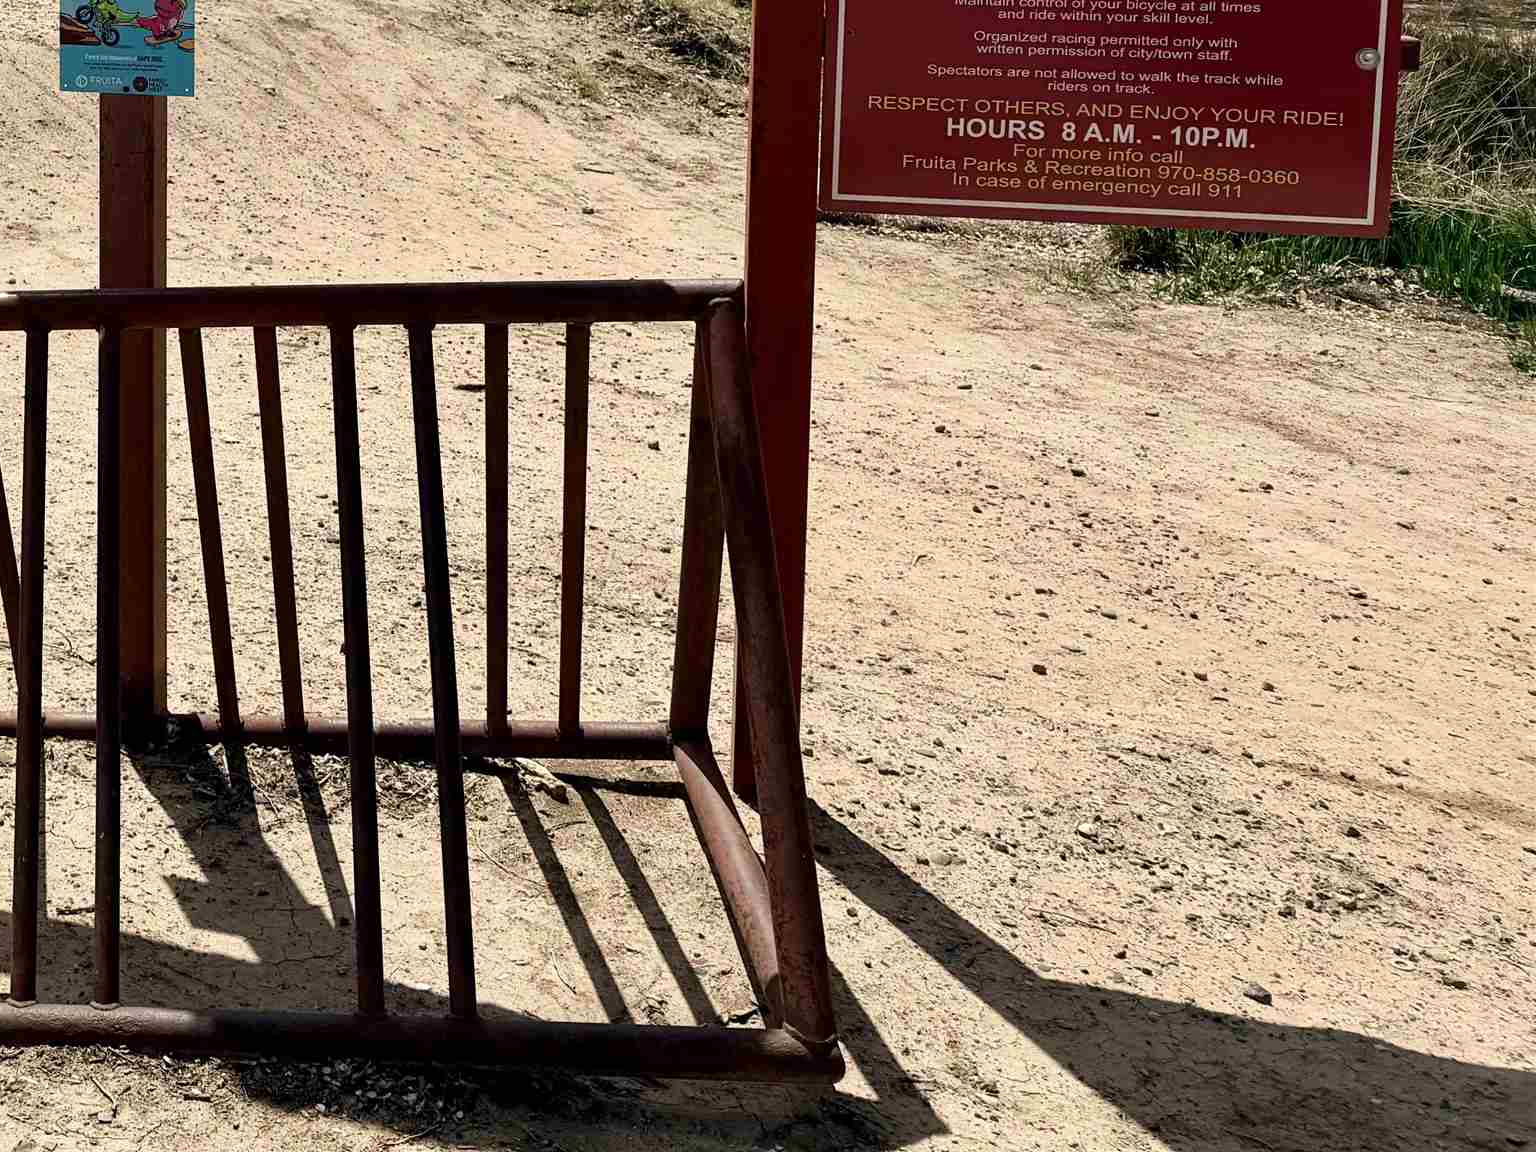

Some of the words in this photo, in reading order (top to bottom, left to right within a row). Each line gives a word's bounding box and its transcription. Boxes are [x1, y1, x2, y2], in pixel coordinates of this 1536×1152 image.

[973, 29, 1048, 45] Organized
[1051, 32, 1096, 47] racing
[1099, 34, 1169, 47] permitted
[1172, 35, 1204, 50] only
[1207, 36, 1238, 49] with
[975, 42, 1024, 55] written
[1027, 44, 1106, 57] permission
[1109, 46, 1127, 58] of
[1127, 47, 1193, 62] city/town
[1196, 49, 1233, 62] staff.
[927, 63, 1003, 78] Spectators
[1006, 68, 1031, 78] are
[1033, 68, 1057, 79] not
[1060, 68, 1117, 81] allowed
[1119, 70, 1135, 81] to
[1138, 70, 1172, 83] walk
[1176, 71, 1201, 84] the
[1203, 72, 1241, 85] track
[1244, 72, 1284, 87] while
[1047, 79, 1089, 93] riders
[1091, 83, 1111, 93] on
[1114, 82, 1155, 95] track.
[867, 94, 969, 113] RESPECT
[974, 98, 1070, 118] OTHERS,
[1075, 103, 1123, 118] AND
[1129, 104, 1206, 121] ENJOY
[1210, 106, 1277, 125] YOUR
[1282, 109, 1344, 127] RIDE!
[946, 116, 1046, 141] HOURS
[1061, 121, 1077, 142] 8
[1082, 121, 1142, 145] A.M.
[1169, 125, 1256, 149] 10P.M.
[1013, 143, 1046, 158] For
[1051, 147, 1102, 161] more
[1107, 147, 1144, 163] info
[1149, 149, 1184, 164] call
[902, 154, 957, 170] Fruita
[962, 156, 1018, 173] Parks
[1023, 158, 1039, 174] &
[1044, 159, 1151, 179] Recreation
[1157, 164, 1300, 185] 970-858-0360
[952, 171, 969, 187] In
[975, 175, 1022, 189] case
[1027, 175, 1048, 190] of
[1051, 179, 1162, 198] emergency
[1167, 182, 1201, 197] call
[1207, 182, 1241, 199] 911
